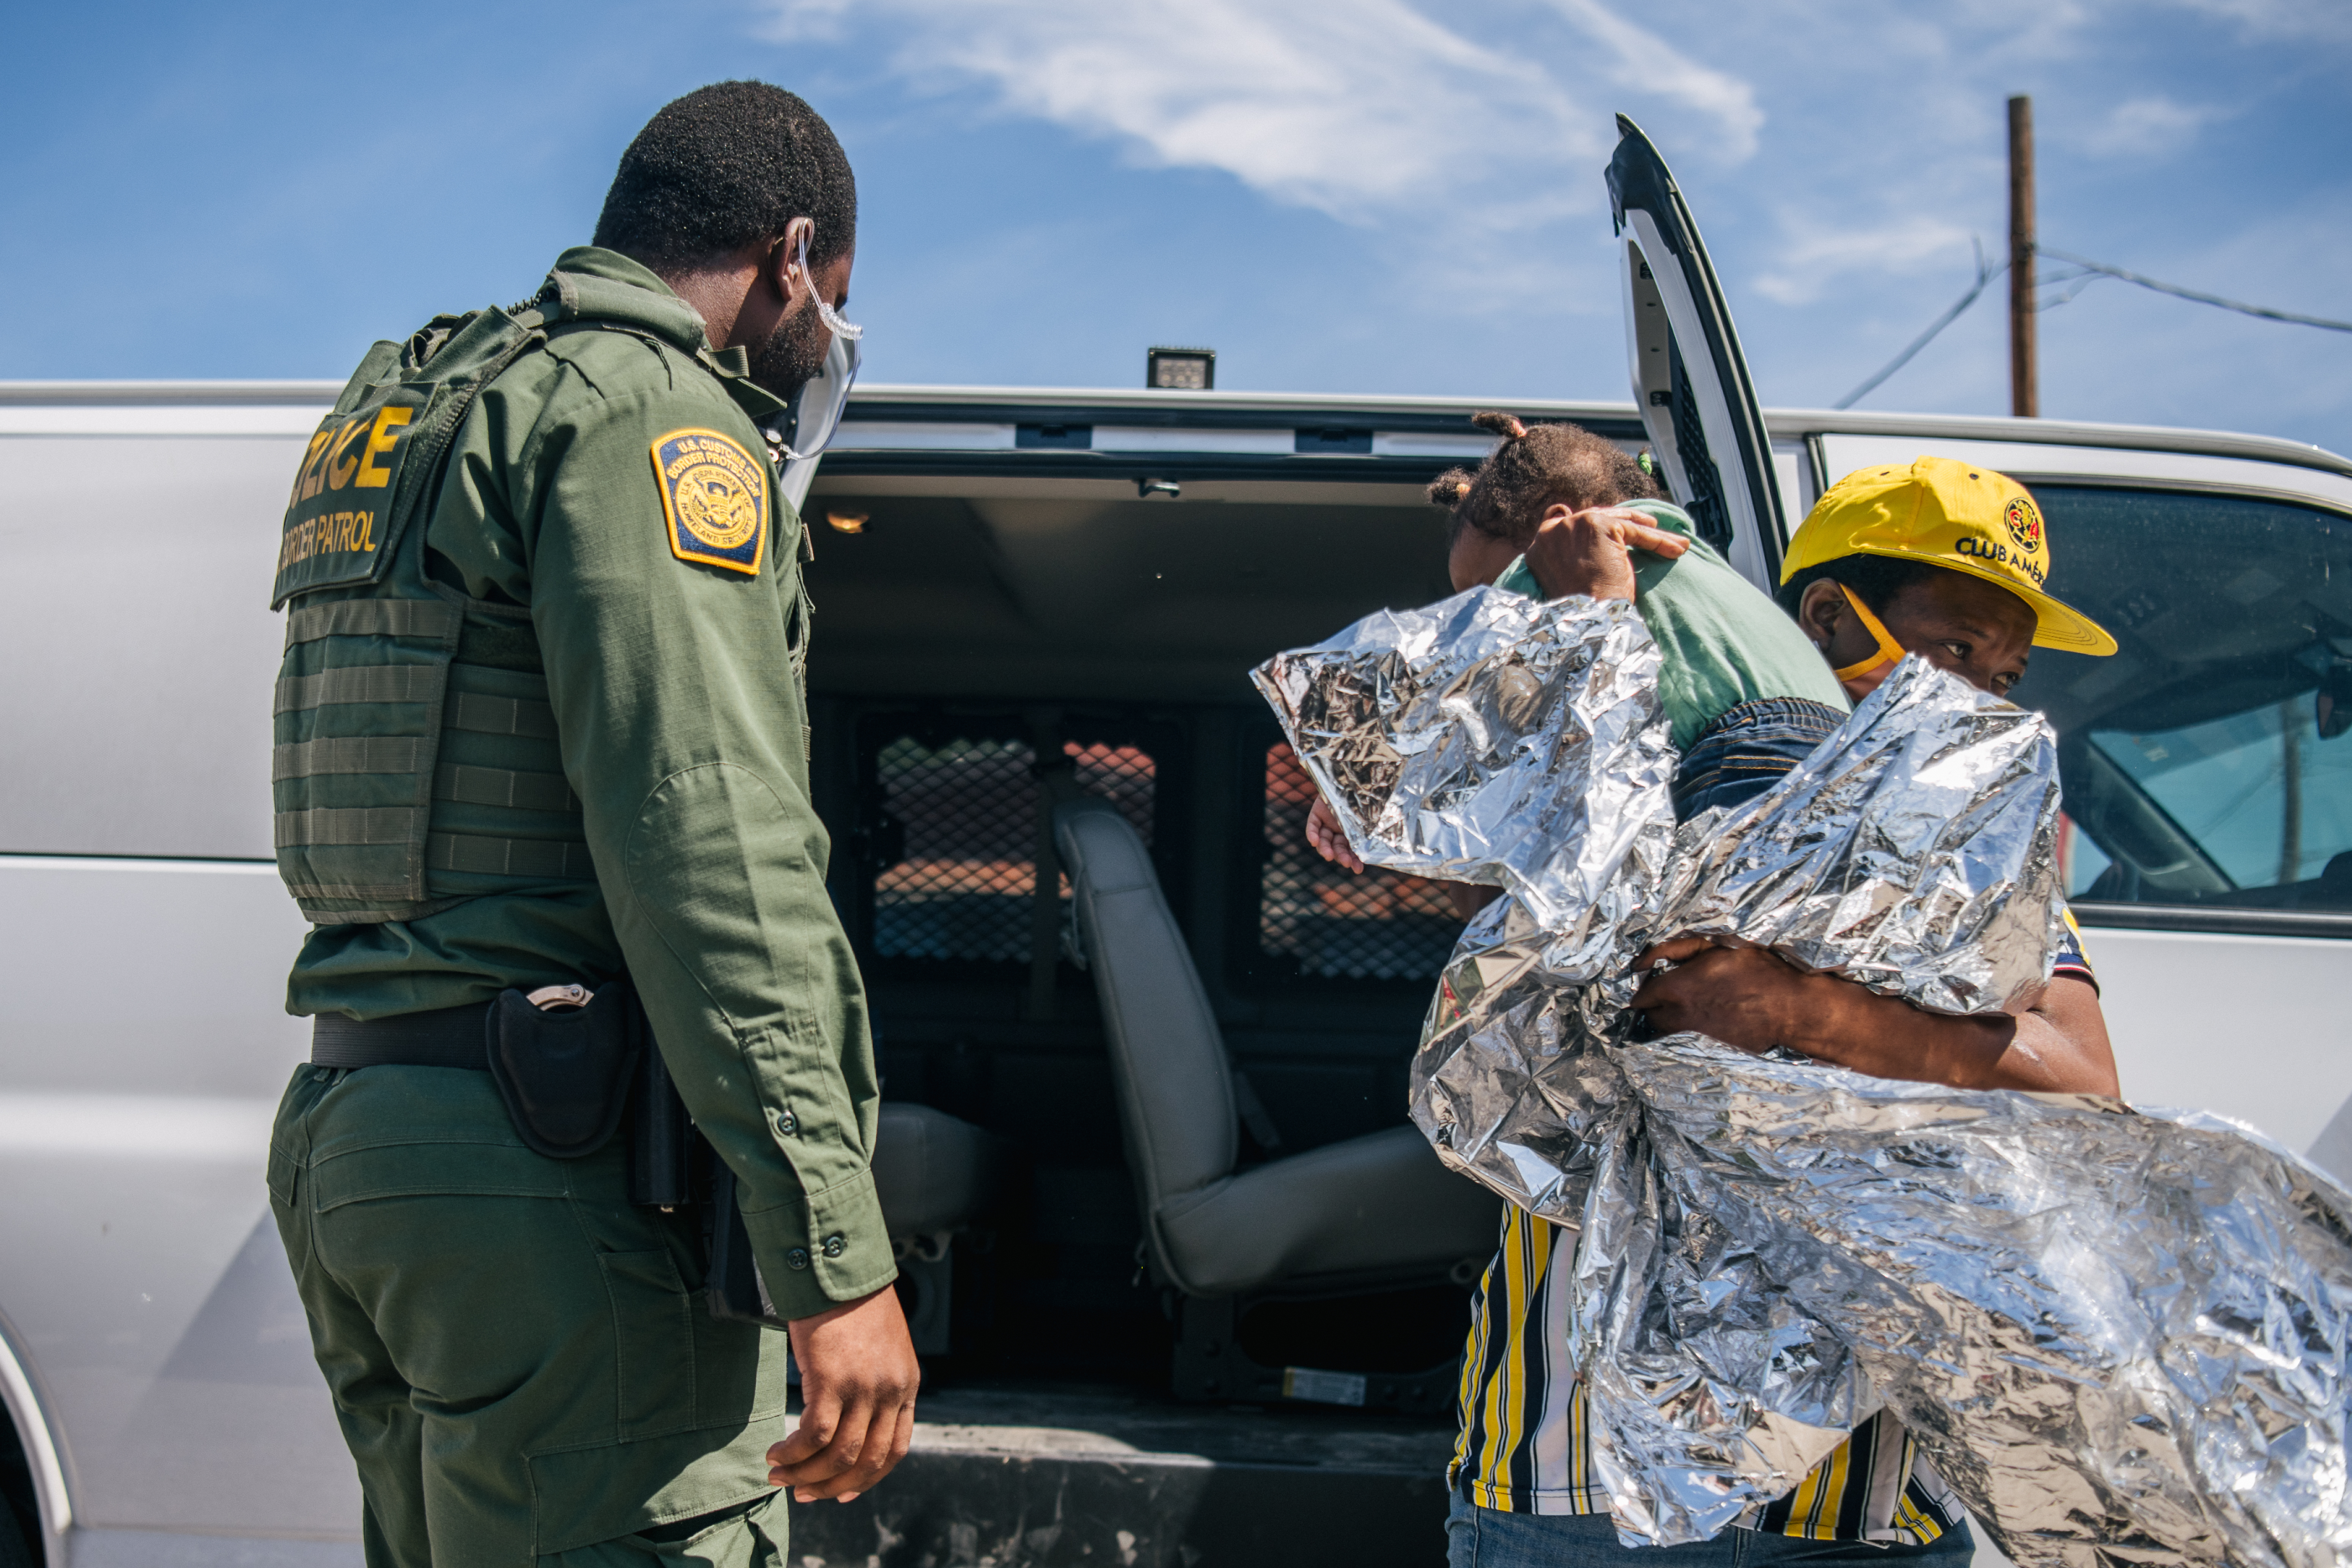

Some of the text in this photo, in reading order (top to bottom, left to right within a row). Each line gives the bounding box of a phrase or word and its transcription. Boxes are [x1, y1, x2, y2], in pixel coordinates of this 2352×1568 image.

[666, 451, 761, 496] BORDER PROTECTION
[677, 439, 760, 483] U.S. CUSTOMS AND
[681, 503, 753, 544] HOMELAND SECURITY
[744, 498, 753, 509] OF
[281, 511, 376, 571] BORDER PATROL
[1955, 537, 2007, 562] CLUB
